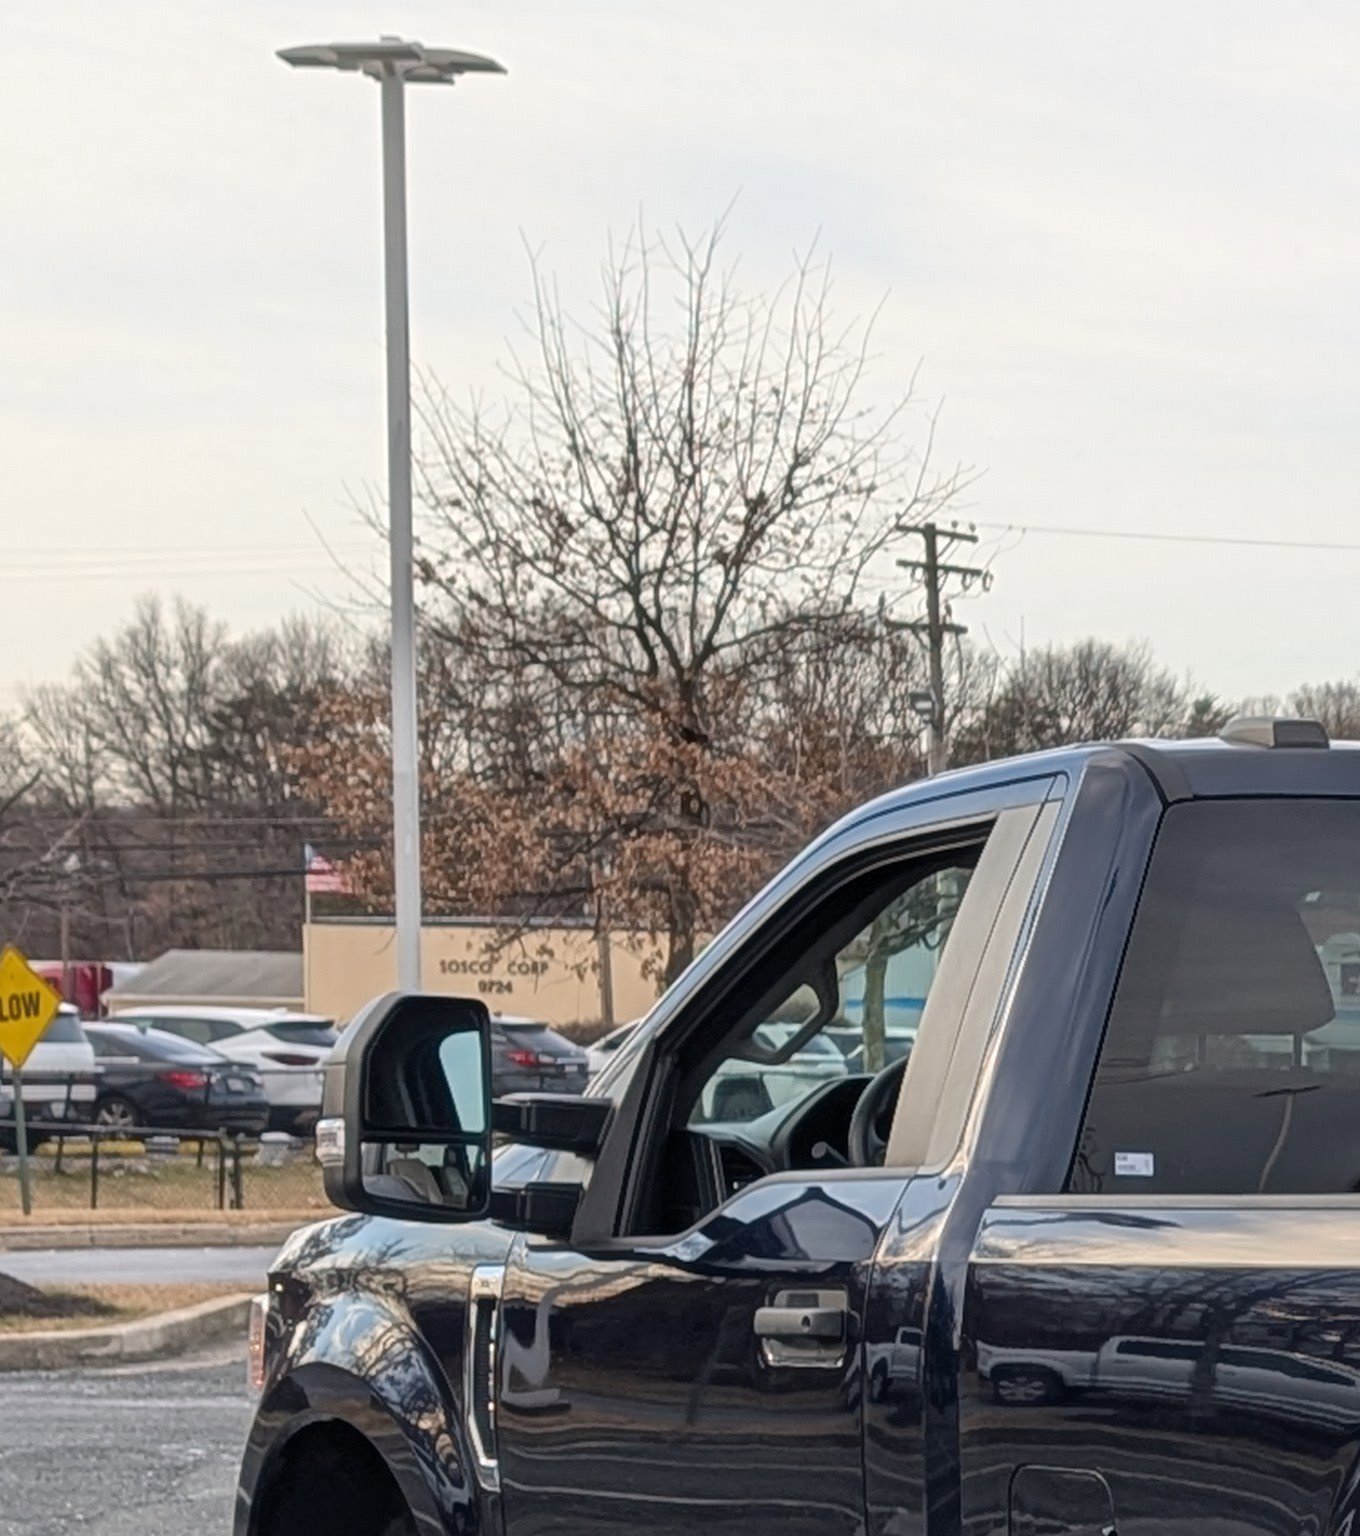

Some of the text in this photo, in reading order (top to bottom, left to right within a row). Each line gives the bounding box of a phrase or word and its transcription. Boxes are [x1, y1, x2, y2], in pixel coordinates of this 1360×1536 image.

[440, 960, 549, 975] SOSCO CORP
[0, 992, 40, 1022] LOW
